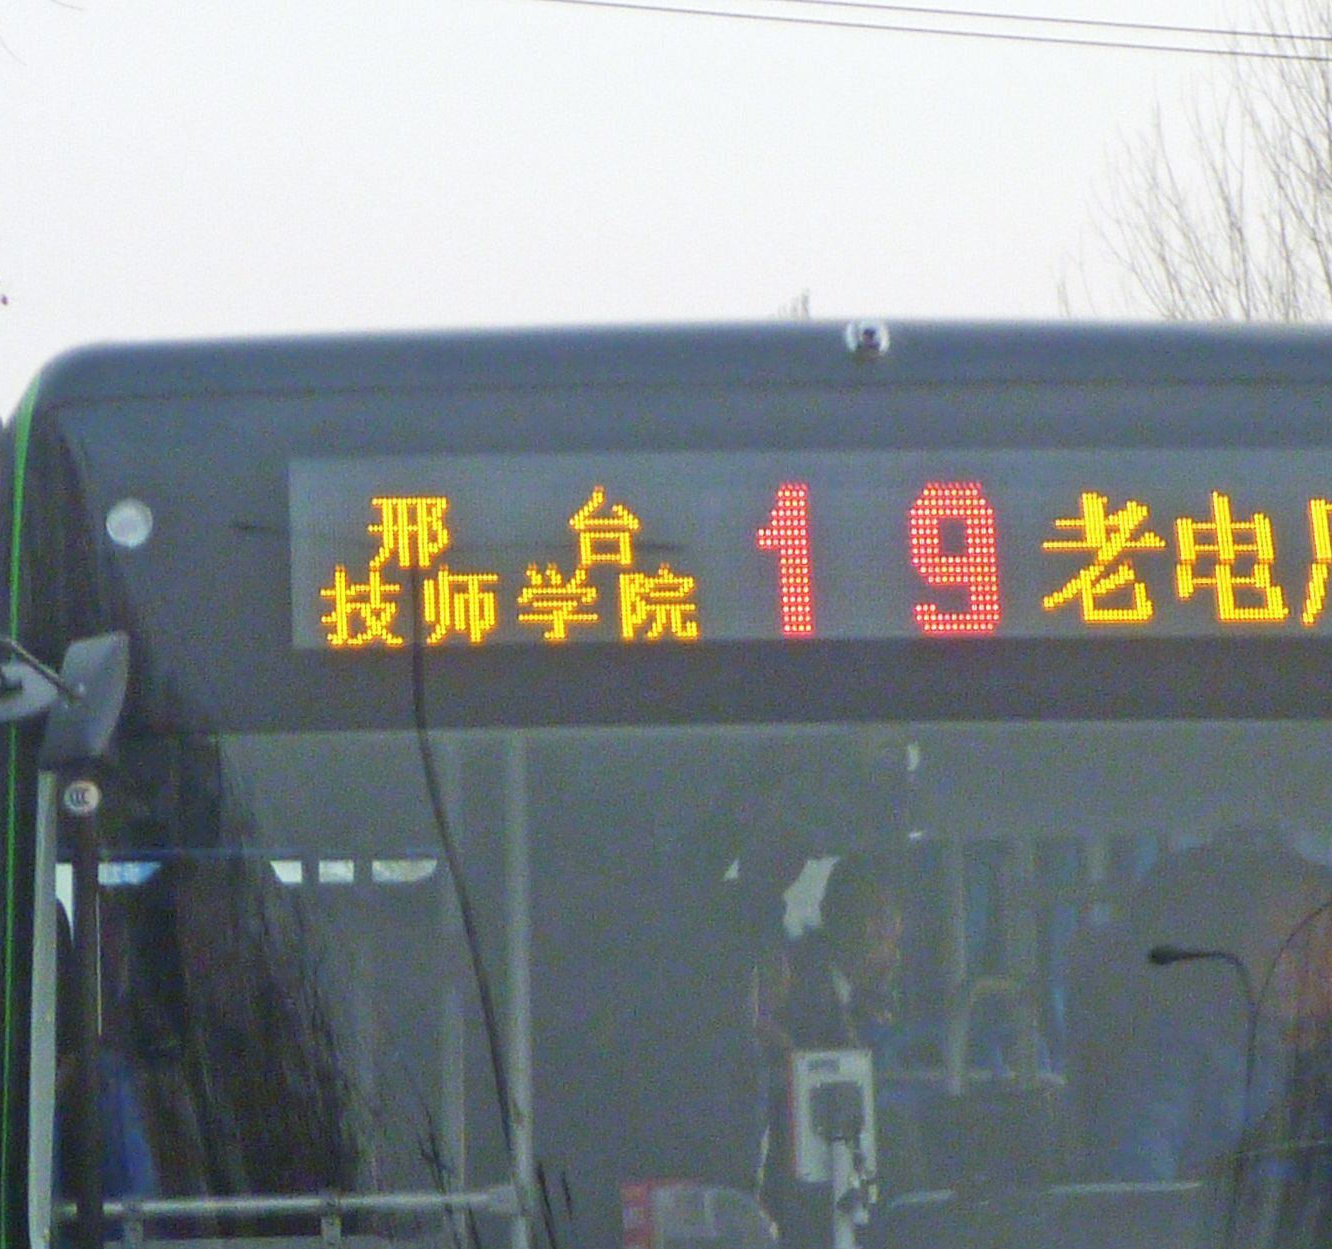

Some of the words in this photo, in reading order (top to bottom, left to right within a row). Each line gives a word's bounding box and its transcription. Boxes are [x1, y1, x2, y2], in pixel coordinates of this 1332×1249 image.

[367, 486, 642, 568] 邢台
[755, 481, 1003, 639] 19
[319, 564, 701, 648] 技师学院
